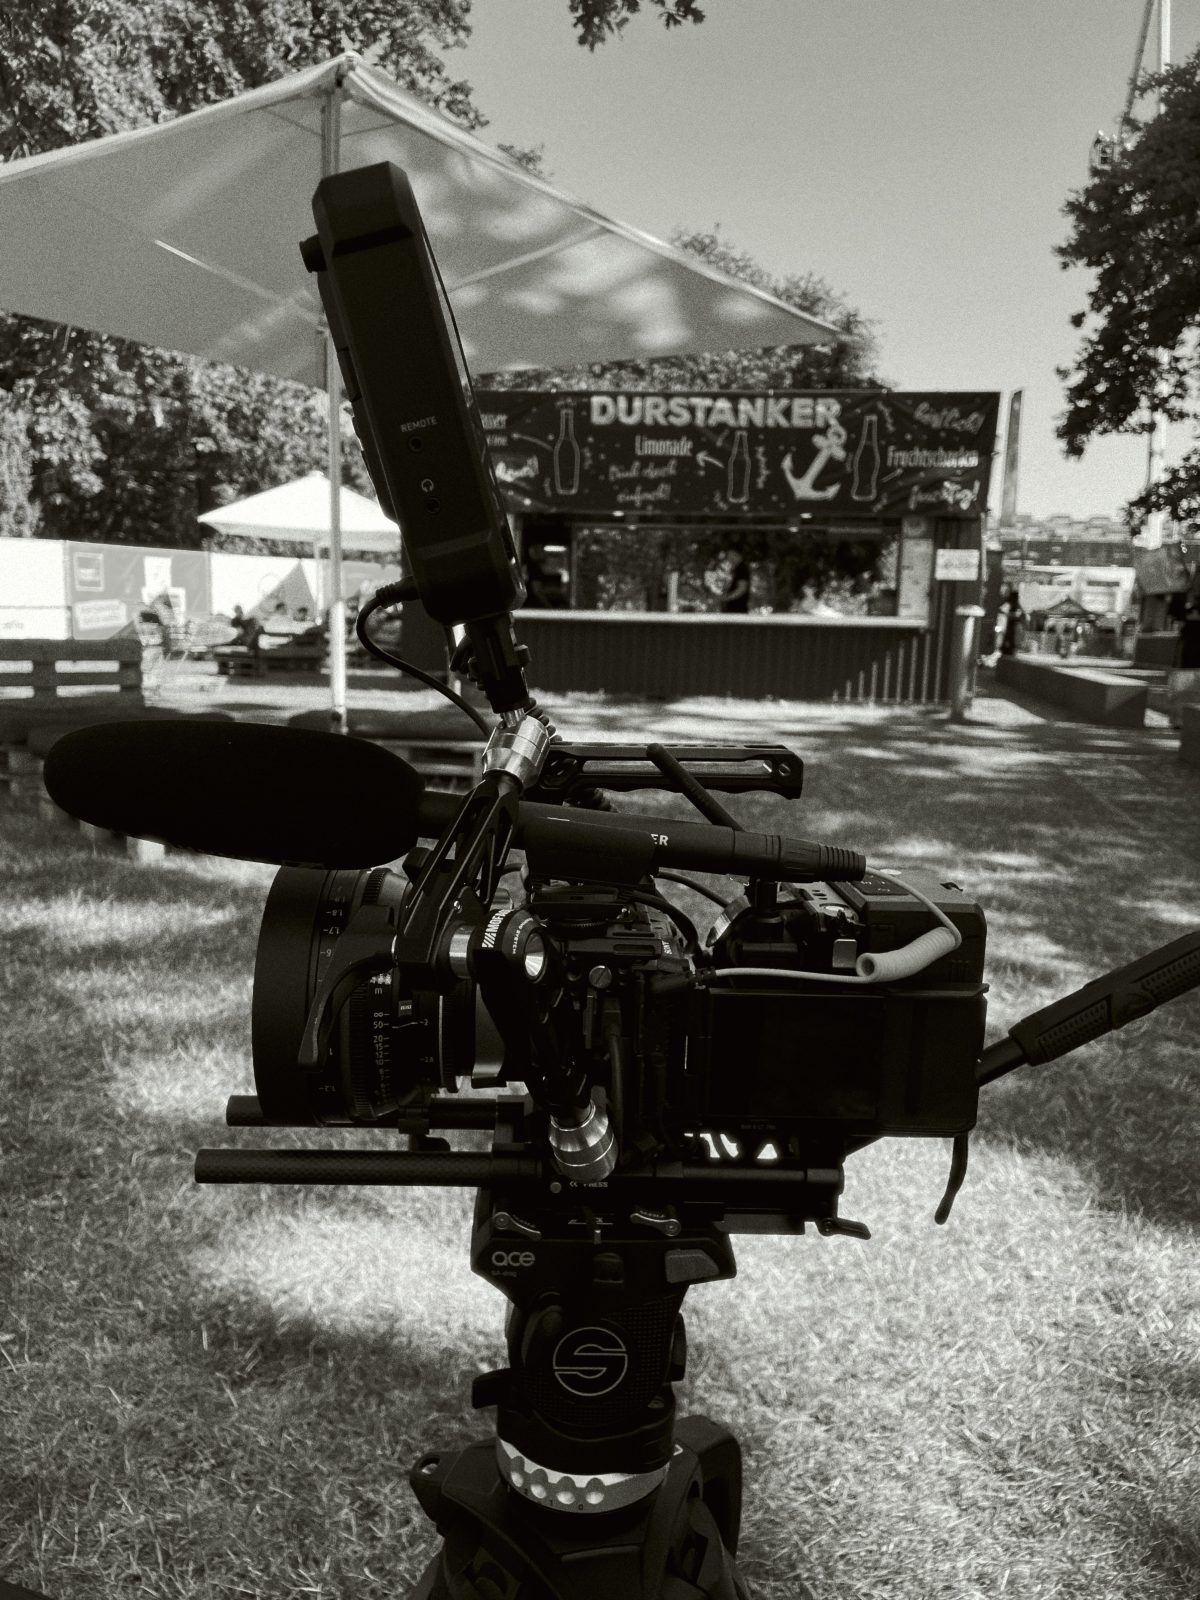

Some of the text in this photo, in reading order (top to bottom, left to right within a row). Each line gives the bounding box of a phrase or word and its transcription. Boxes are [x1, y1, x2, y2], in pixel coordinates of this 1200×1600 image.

[590, 395, 842, 428] DURSTANKER
[399, 415, 438, 433] REMOTE
[373, 1021, 384, 1029] 50
[490, 1250, 536, 1267] ace
